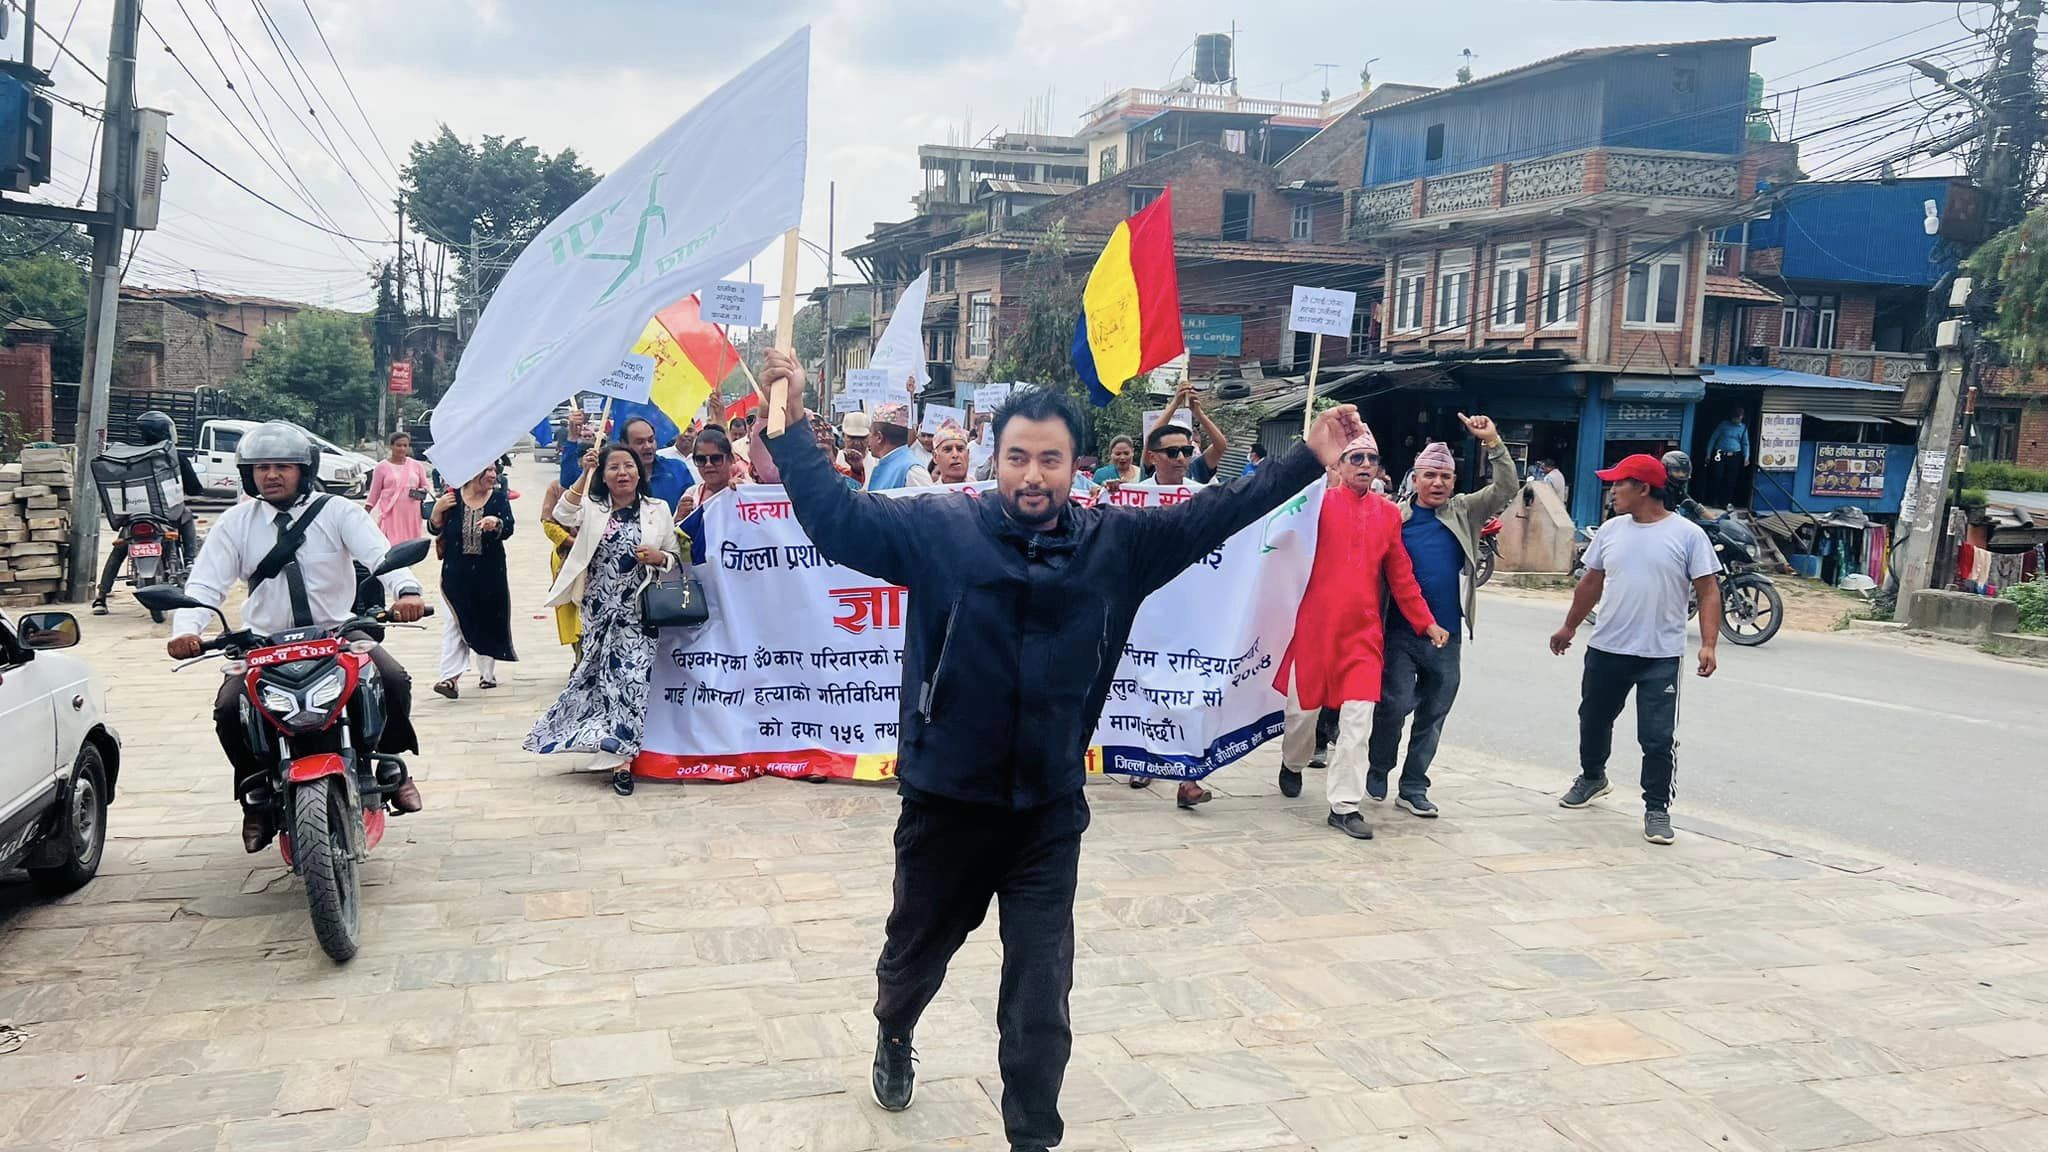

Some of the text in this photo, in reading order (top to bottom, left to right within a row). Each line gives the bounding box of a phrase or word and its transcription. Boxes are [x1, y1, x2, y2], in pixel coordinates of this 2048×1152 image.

[1203, 332, 1236, 342] Center
[721, 540, 779, 572] जिल्ला
[828, 585, 910, 636] ज्ञा
[284, 632, 305, 641] TVS
[810, 645, 890, 673] परिवारको
[664, 681, 688, 706] गाई
[754, 681, 811, 707] हत्याको
[759, 717, 784, 738] को
[791, 721, 823, 740] दफा
[1114, 754, 1146, 774] जिल्ला
